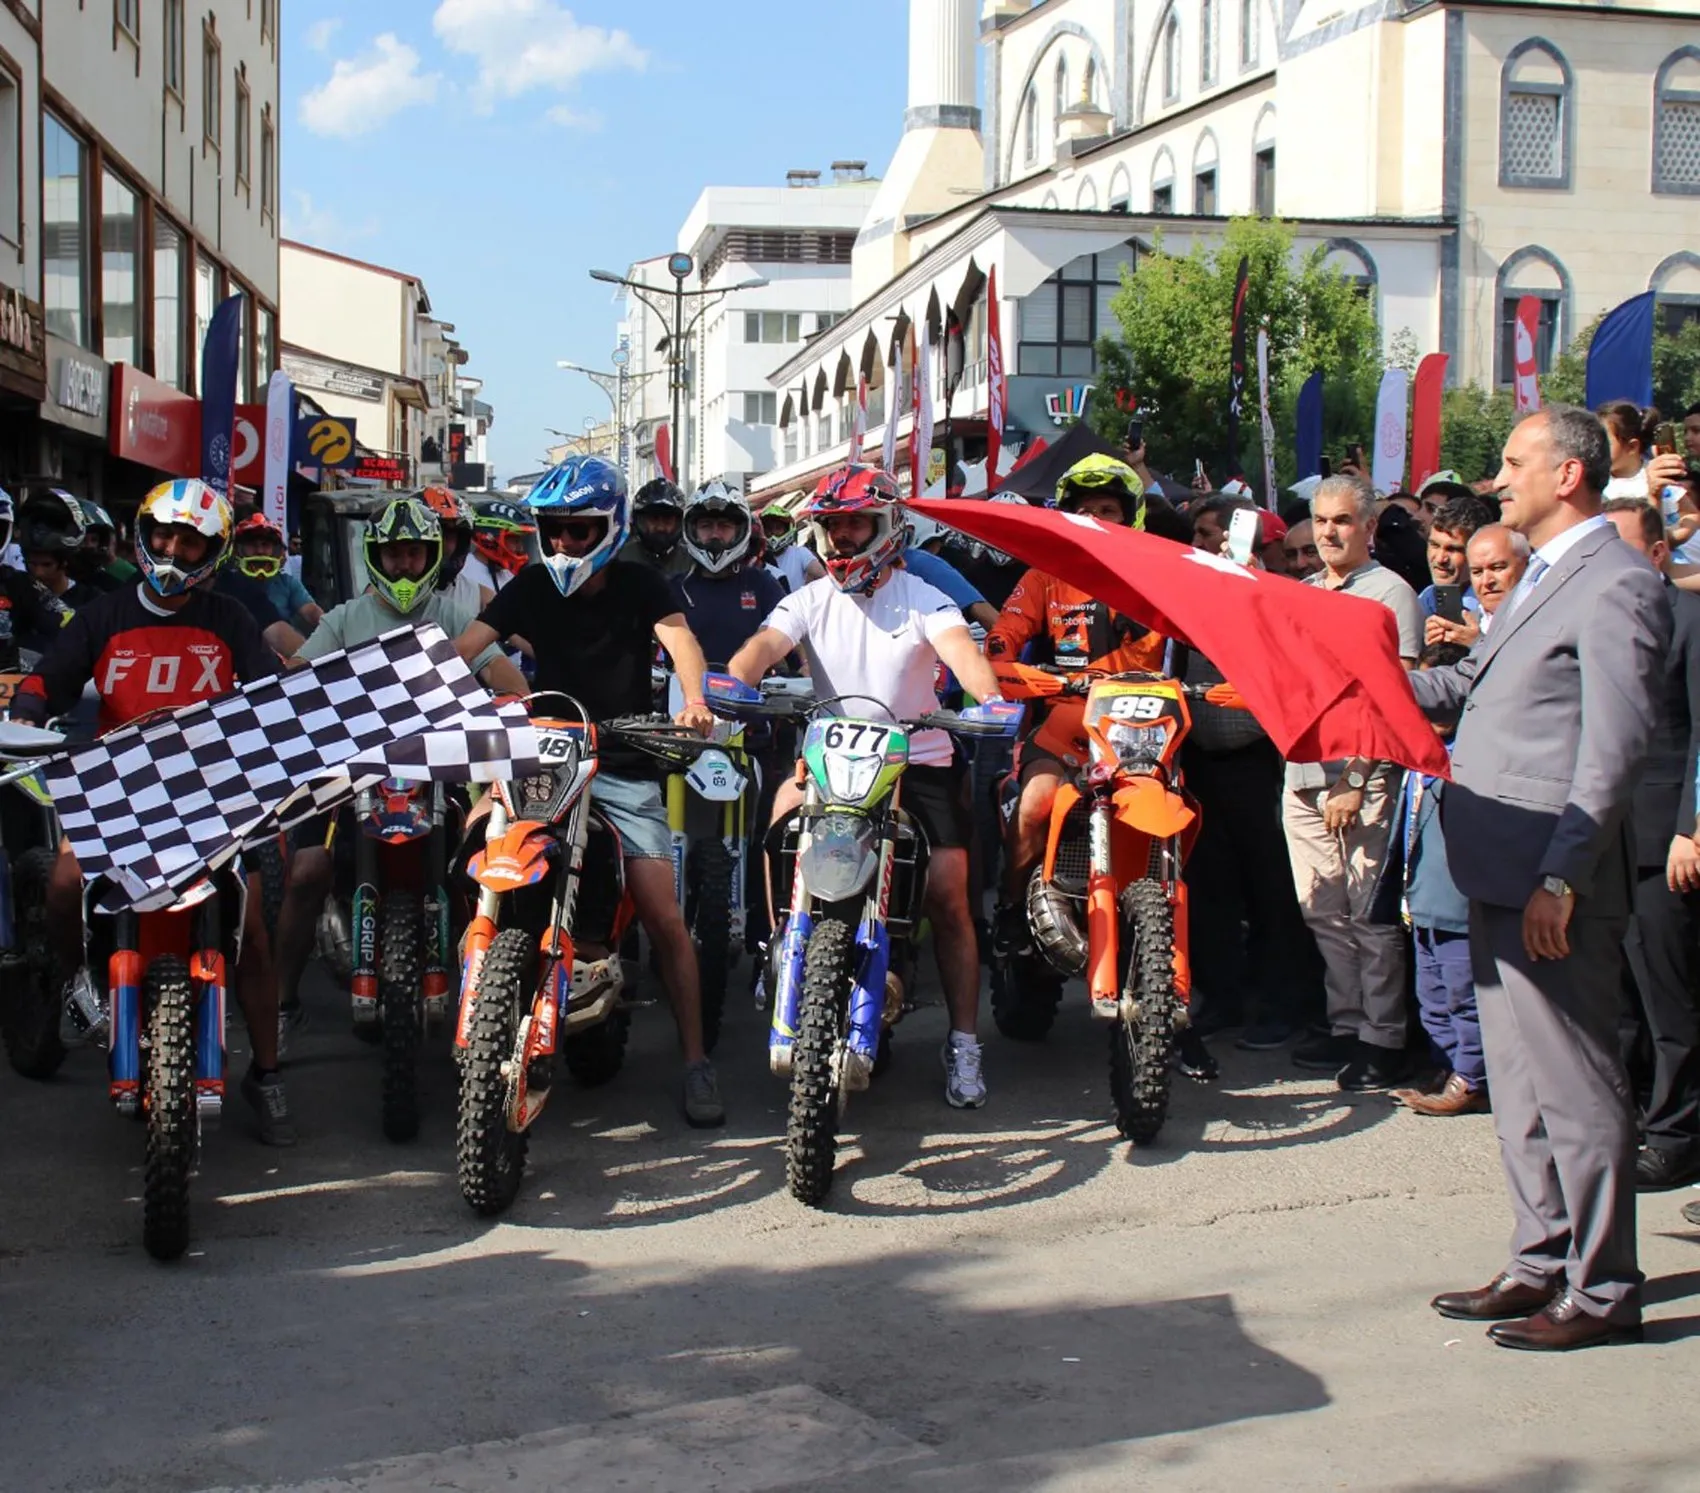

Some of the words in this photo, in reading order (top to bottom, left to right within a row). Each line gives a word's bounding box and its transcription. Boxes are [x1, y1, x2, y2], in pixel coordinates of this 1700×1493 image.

[103, 656, 222, 694] FOX
[1109, 696, 1164, 719] 99
[825, 722, 888, 753] 677
